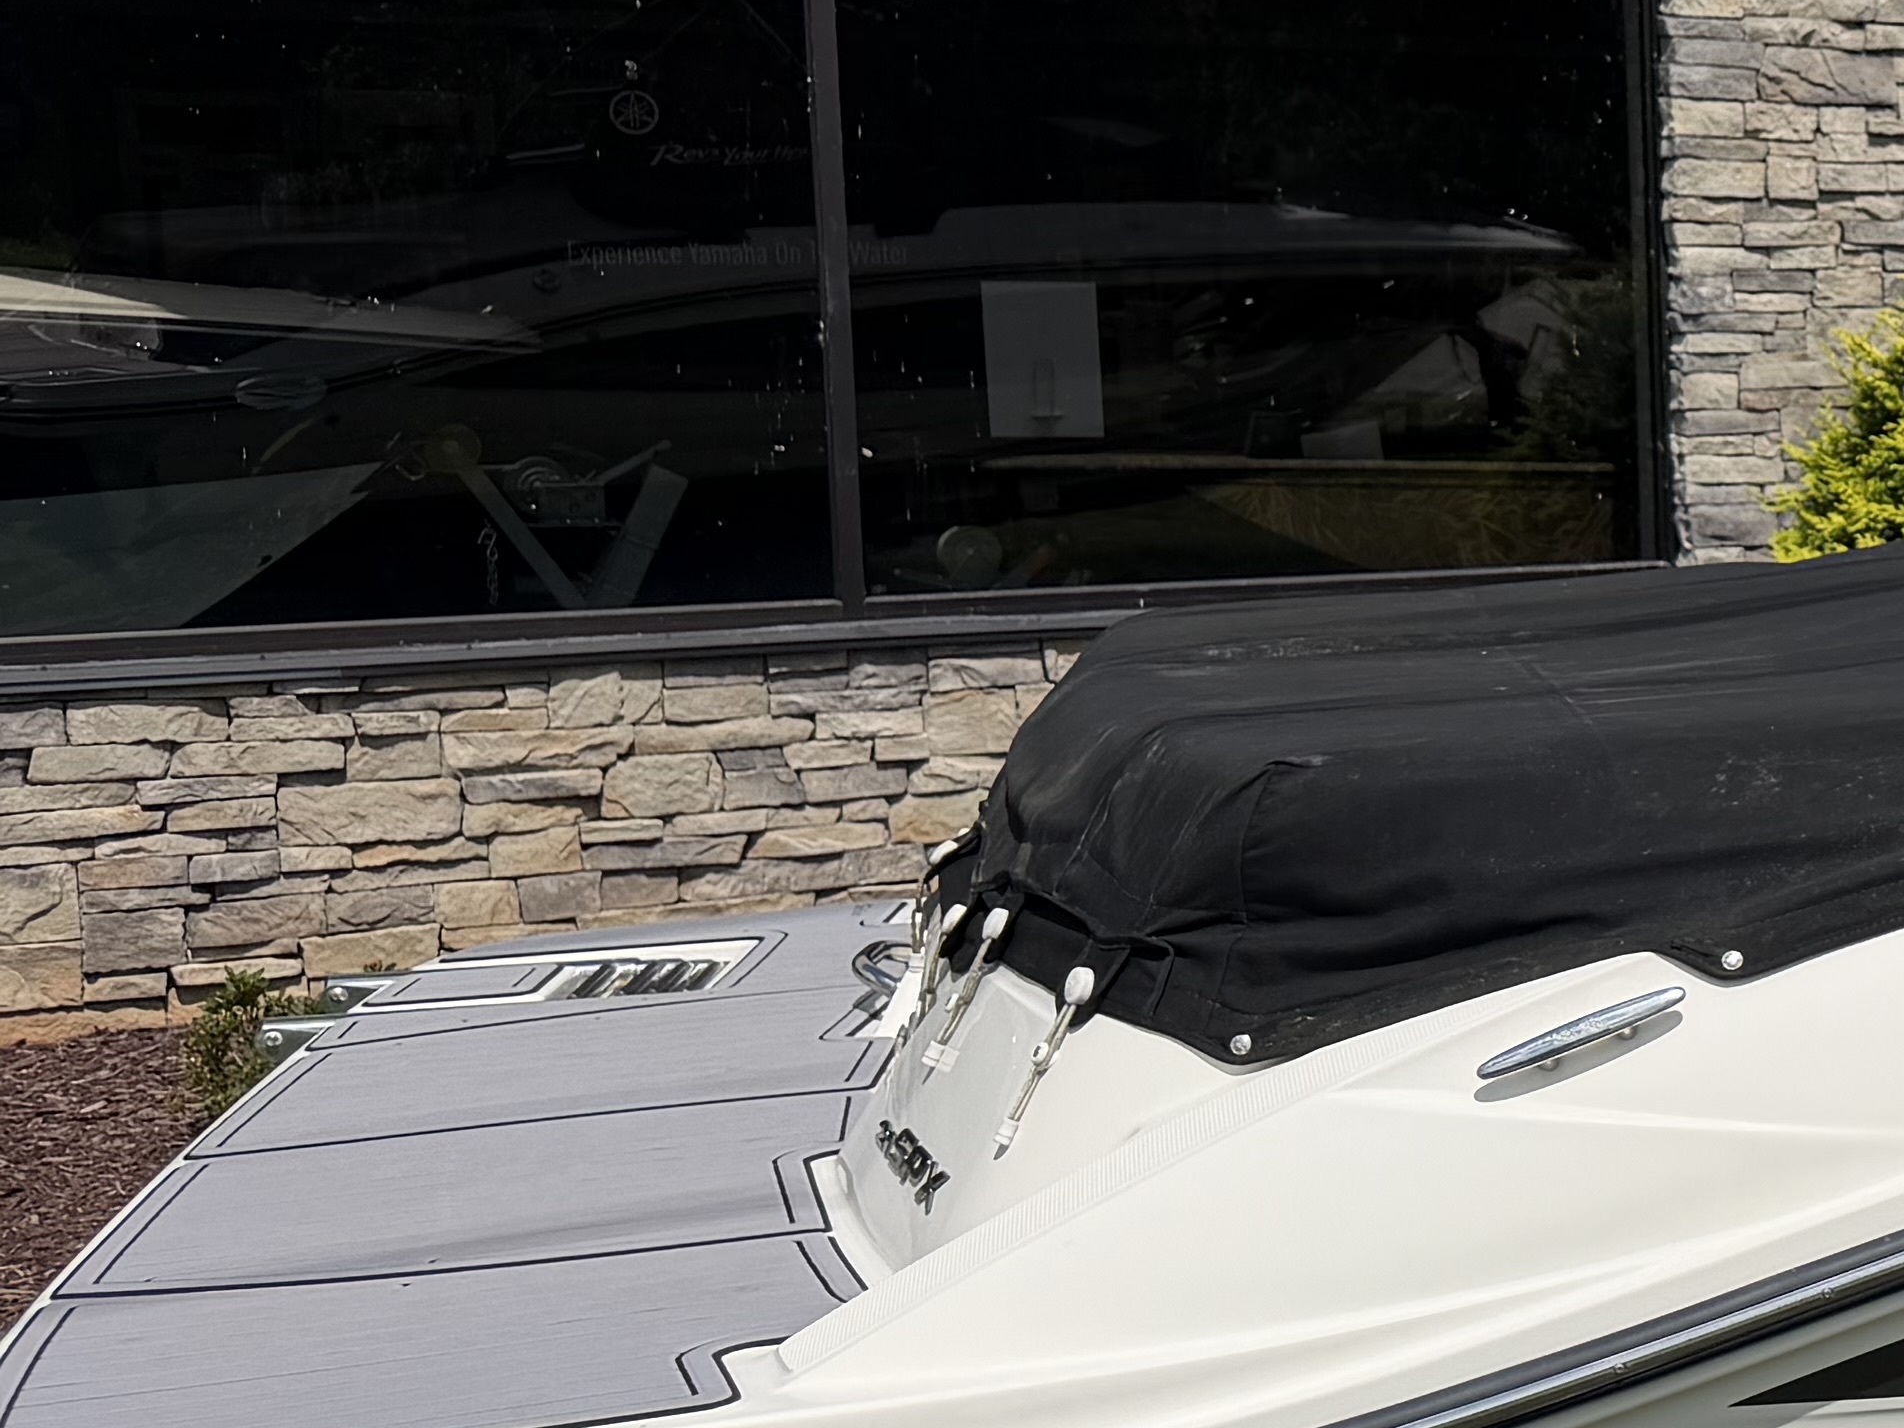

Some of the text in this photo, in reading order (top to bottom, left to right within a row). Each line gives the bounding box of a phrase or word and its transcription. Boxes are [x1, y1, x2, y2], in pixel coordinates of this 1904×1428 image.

[567, 239, 682, 270] Experience
[688, 240, 767, 265] Yamaha
[775, 242, 802, 264] On
[849, 241, 909, 265] Water
